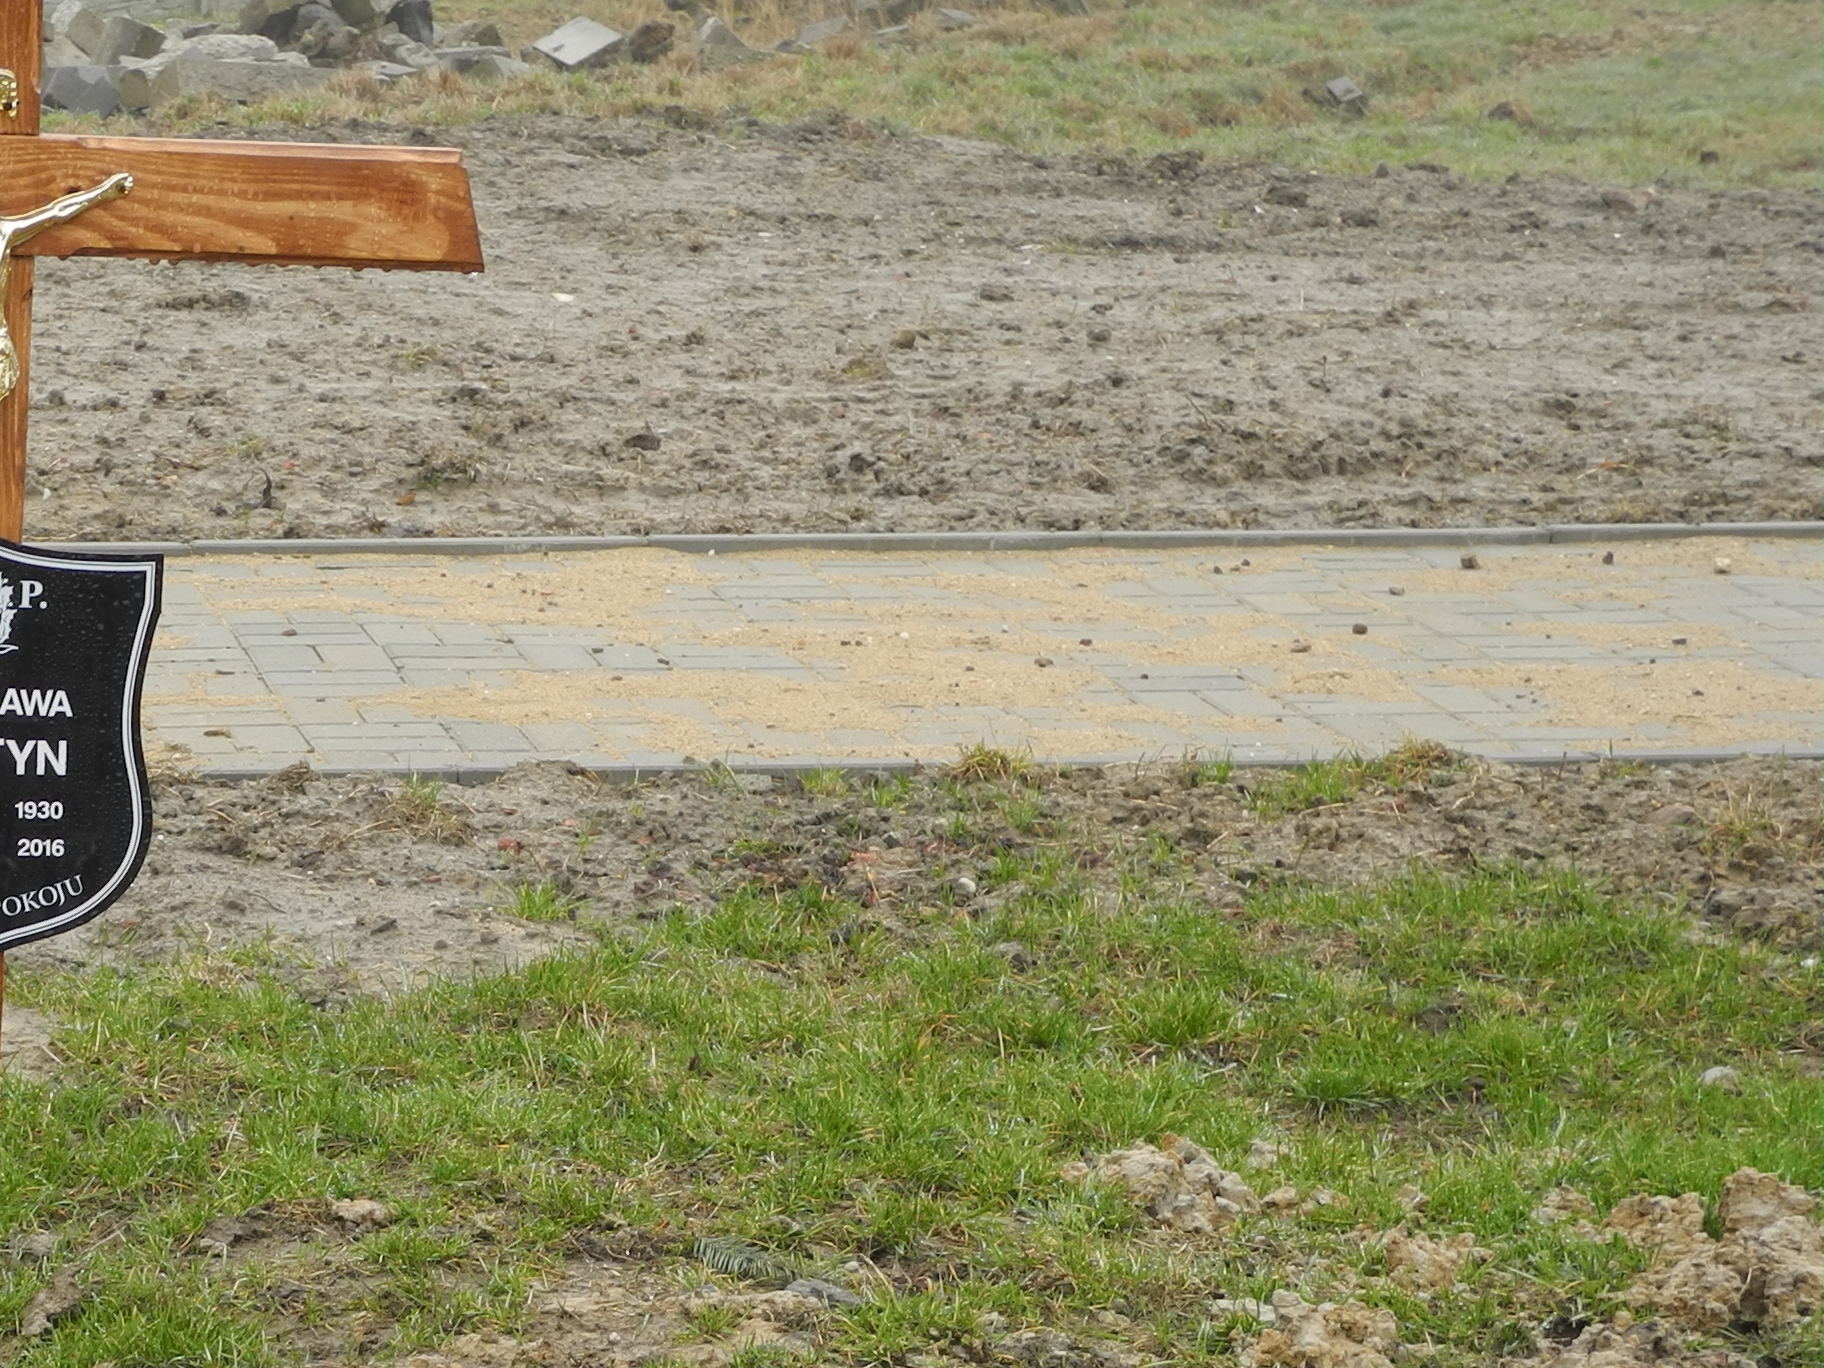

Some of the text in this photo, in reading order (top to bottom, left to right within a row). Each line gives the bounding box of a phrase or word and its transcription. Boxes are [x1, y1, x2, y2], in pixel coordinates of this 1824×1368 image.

[18, 579, 49, 610] P.
[14, 800, 64, 820] 1930
[17, 838, 65, 858] 2016
